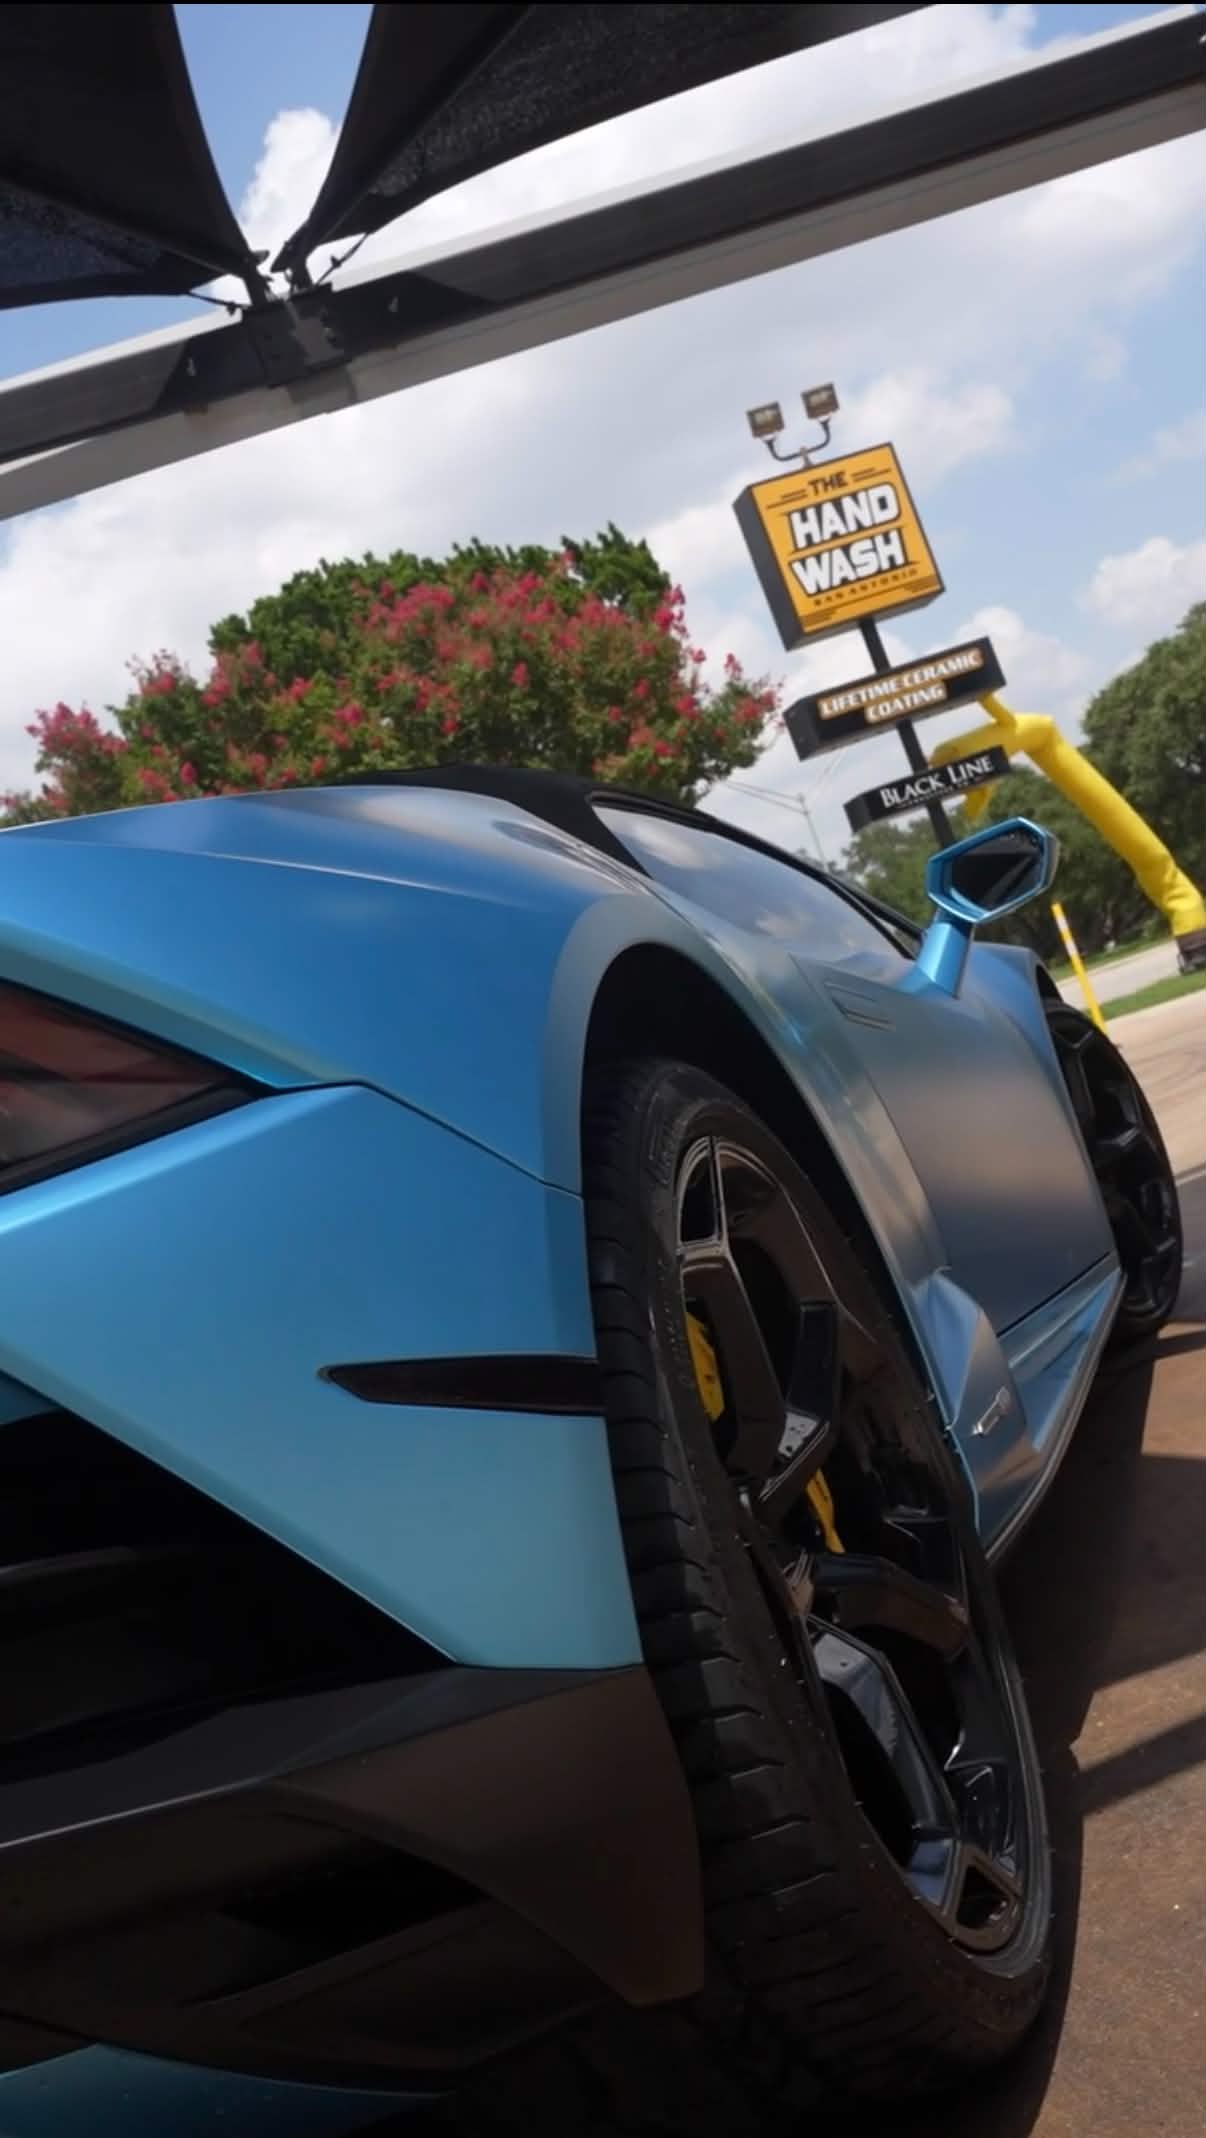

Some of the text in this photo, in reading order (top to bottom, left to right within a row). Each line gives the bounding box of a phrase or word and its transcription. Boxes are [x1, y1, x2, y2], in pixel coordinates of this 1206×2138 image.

[808, 471, 848, 496] THE
[789, 483, 900, 549] HAND
[791, 529, 905, 594] WASH
[820, 650, 980, 716] LIFETIME CERAMIC
[867, 685, 944, 719] COATING
[879, 772, 944, 808] BLACK
[946, 755, 993, 784] LINE
